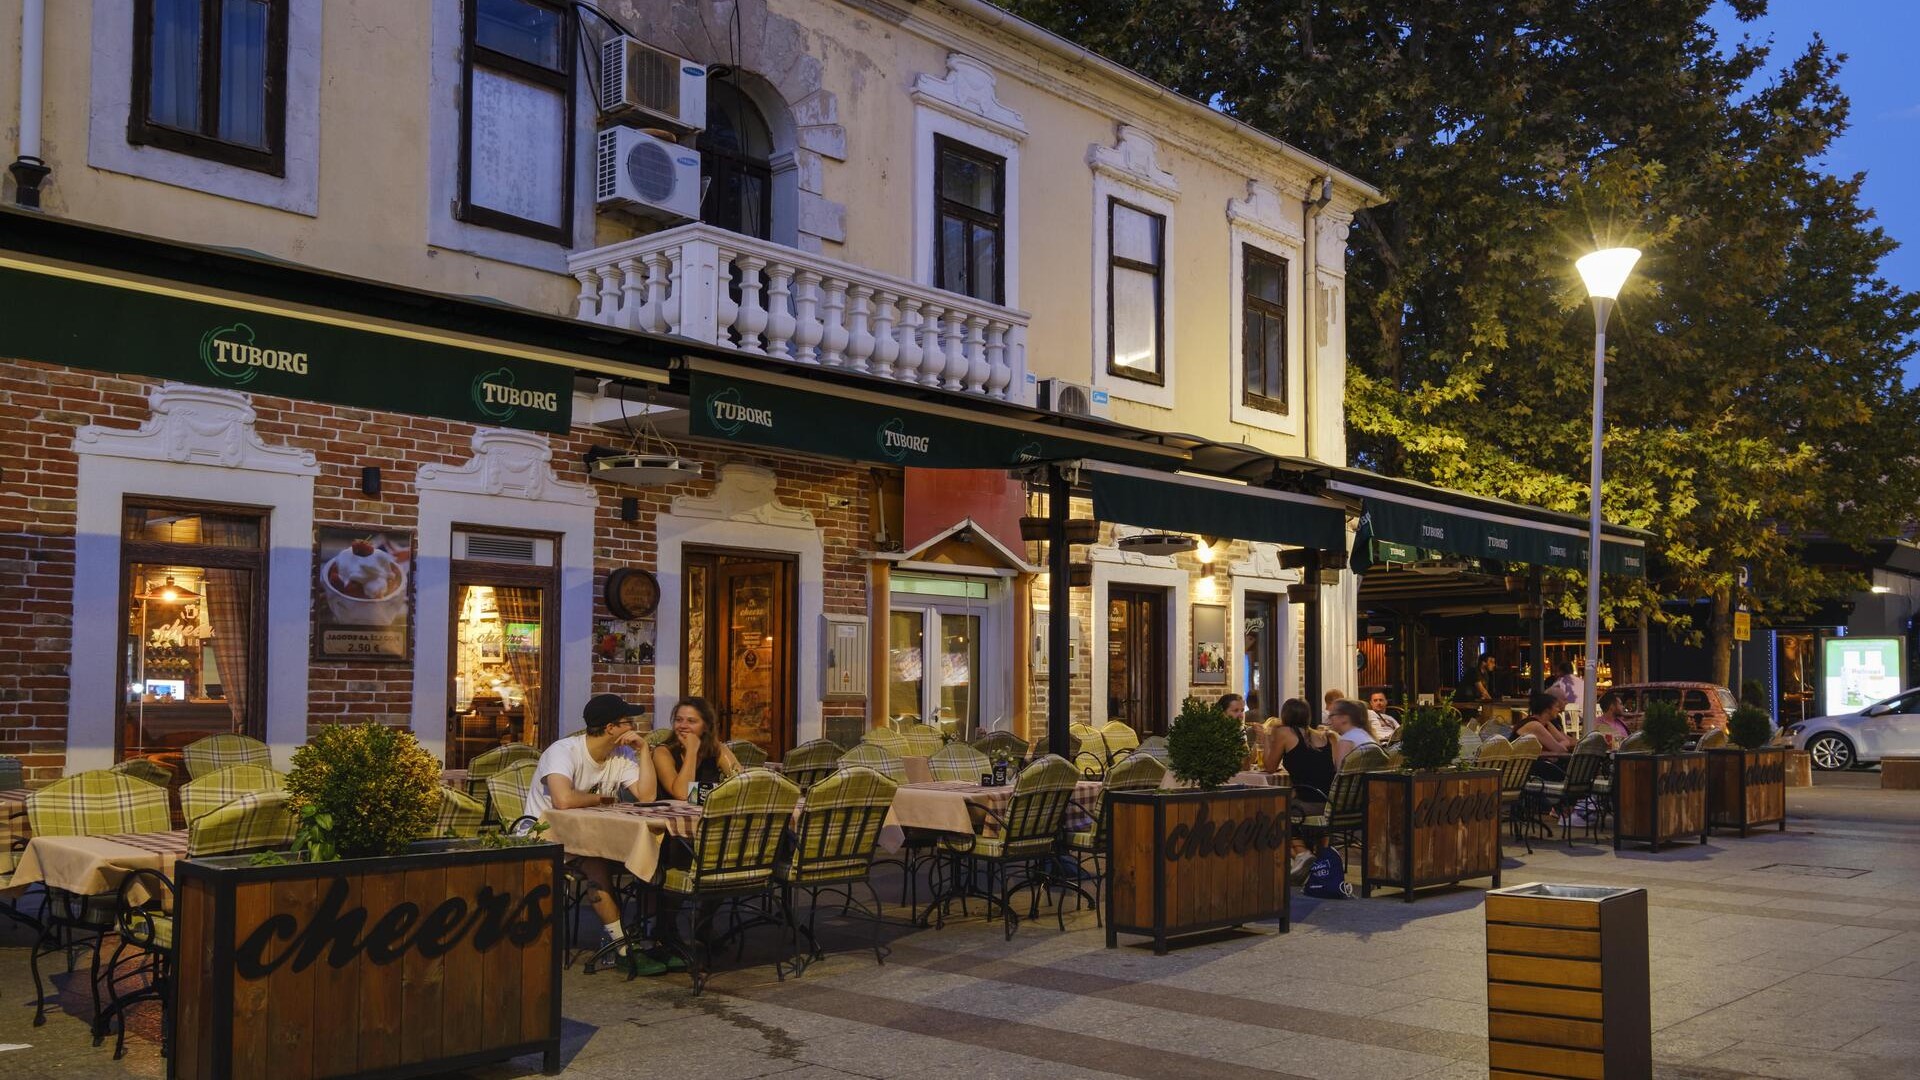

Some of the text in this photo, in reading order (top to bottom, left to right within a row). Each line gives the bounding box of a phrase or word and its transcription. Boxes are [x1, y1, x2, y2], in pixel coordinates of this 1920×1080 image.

[213, 338, 308, 375] TUBORG
[482, 382, 558, 412] TUBORG
[714, 400, 773, 427] TUBORG
[884, 430, 929, 453] TUBORG
[1422, 525, 1444, 539] TUBORG
[1487, 536, 1509, 549] TUBORG
[1166, 799, 1287, 862] cheers
[236, 876, 552, 981] cheers
